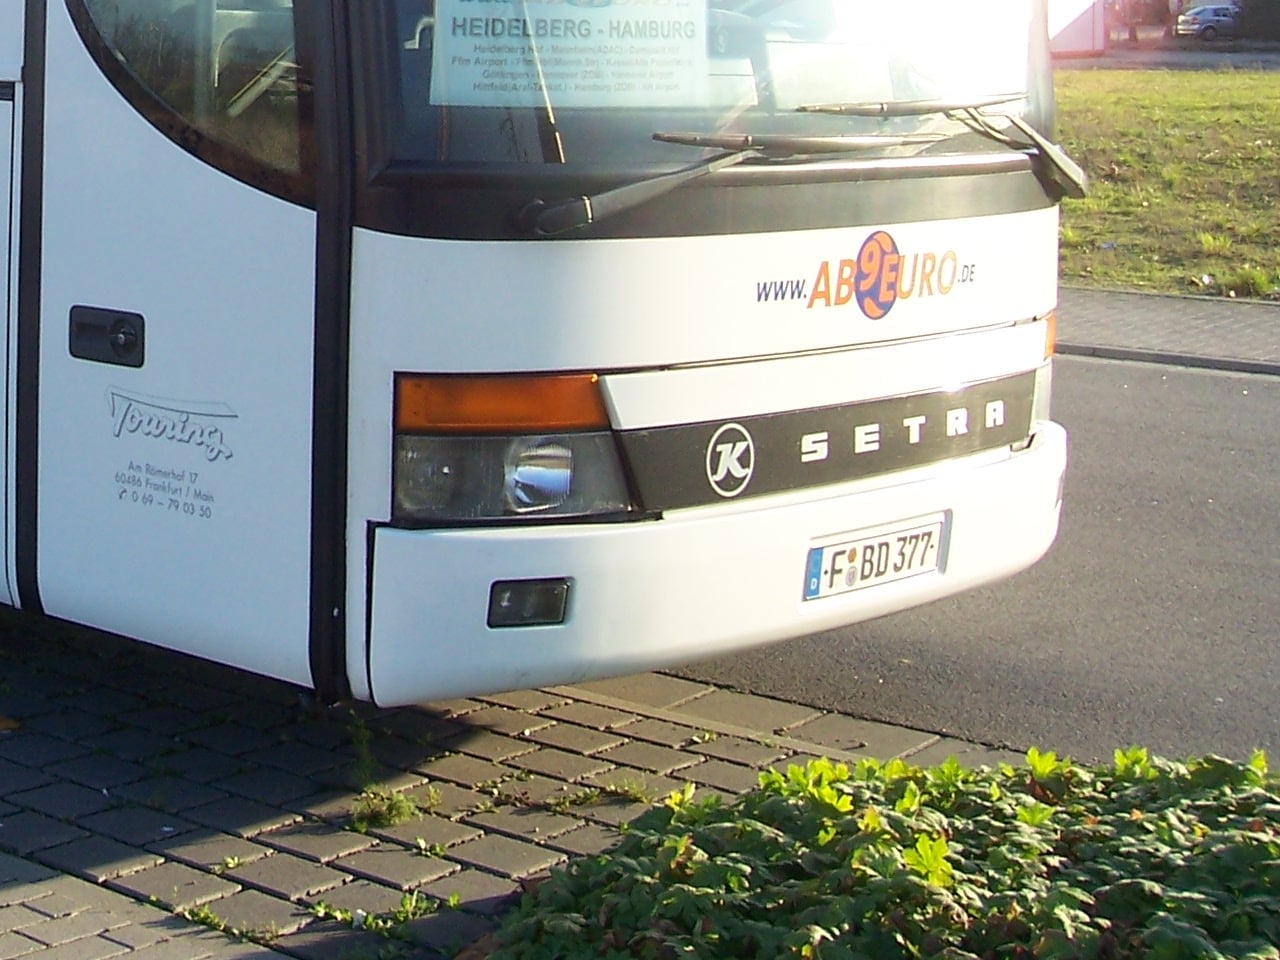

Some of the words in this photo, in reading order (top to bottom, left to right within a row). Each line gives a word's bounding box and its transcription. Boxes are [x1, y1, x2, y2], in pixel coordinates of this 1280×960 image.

[451, 17, 591, 37] HEIDELBERG
[608, 19, 696, 38] HAMBURG
[110, 387, 238, 462] Touring
[801, 400, 1005, 463] SETRA
[189, 471, 198, 484] 17
[193, 488, 214, 502] Main
[828, 550, 847, 589] F
[860, 541, 890, 581] BD
[893, 531, 933, 573] 377
